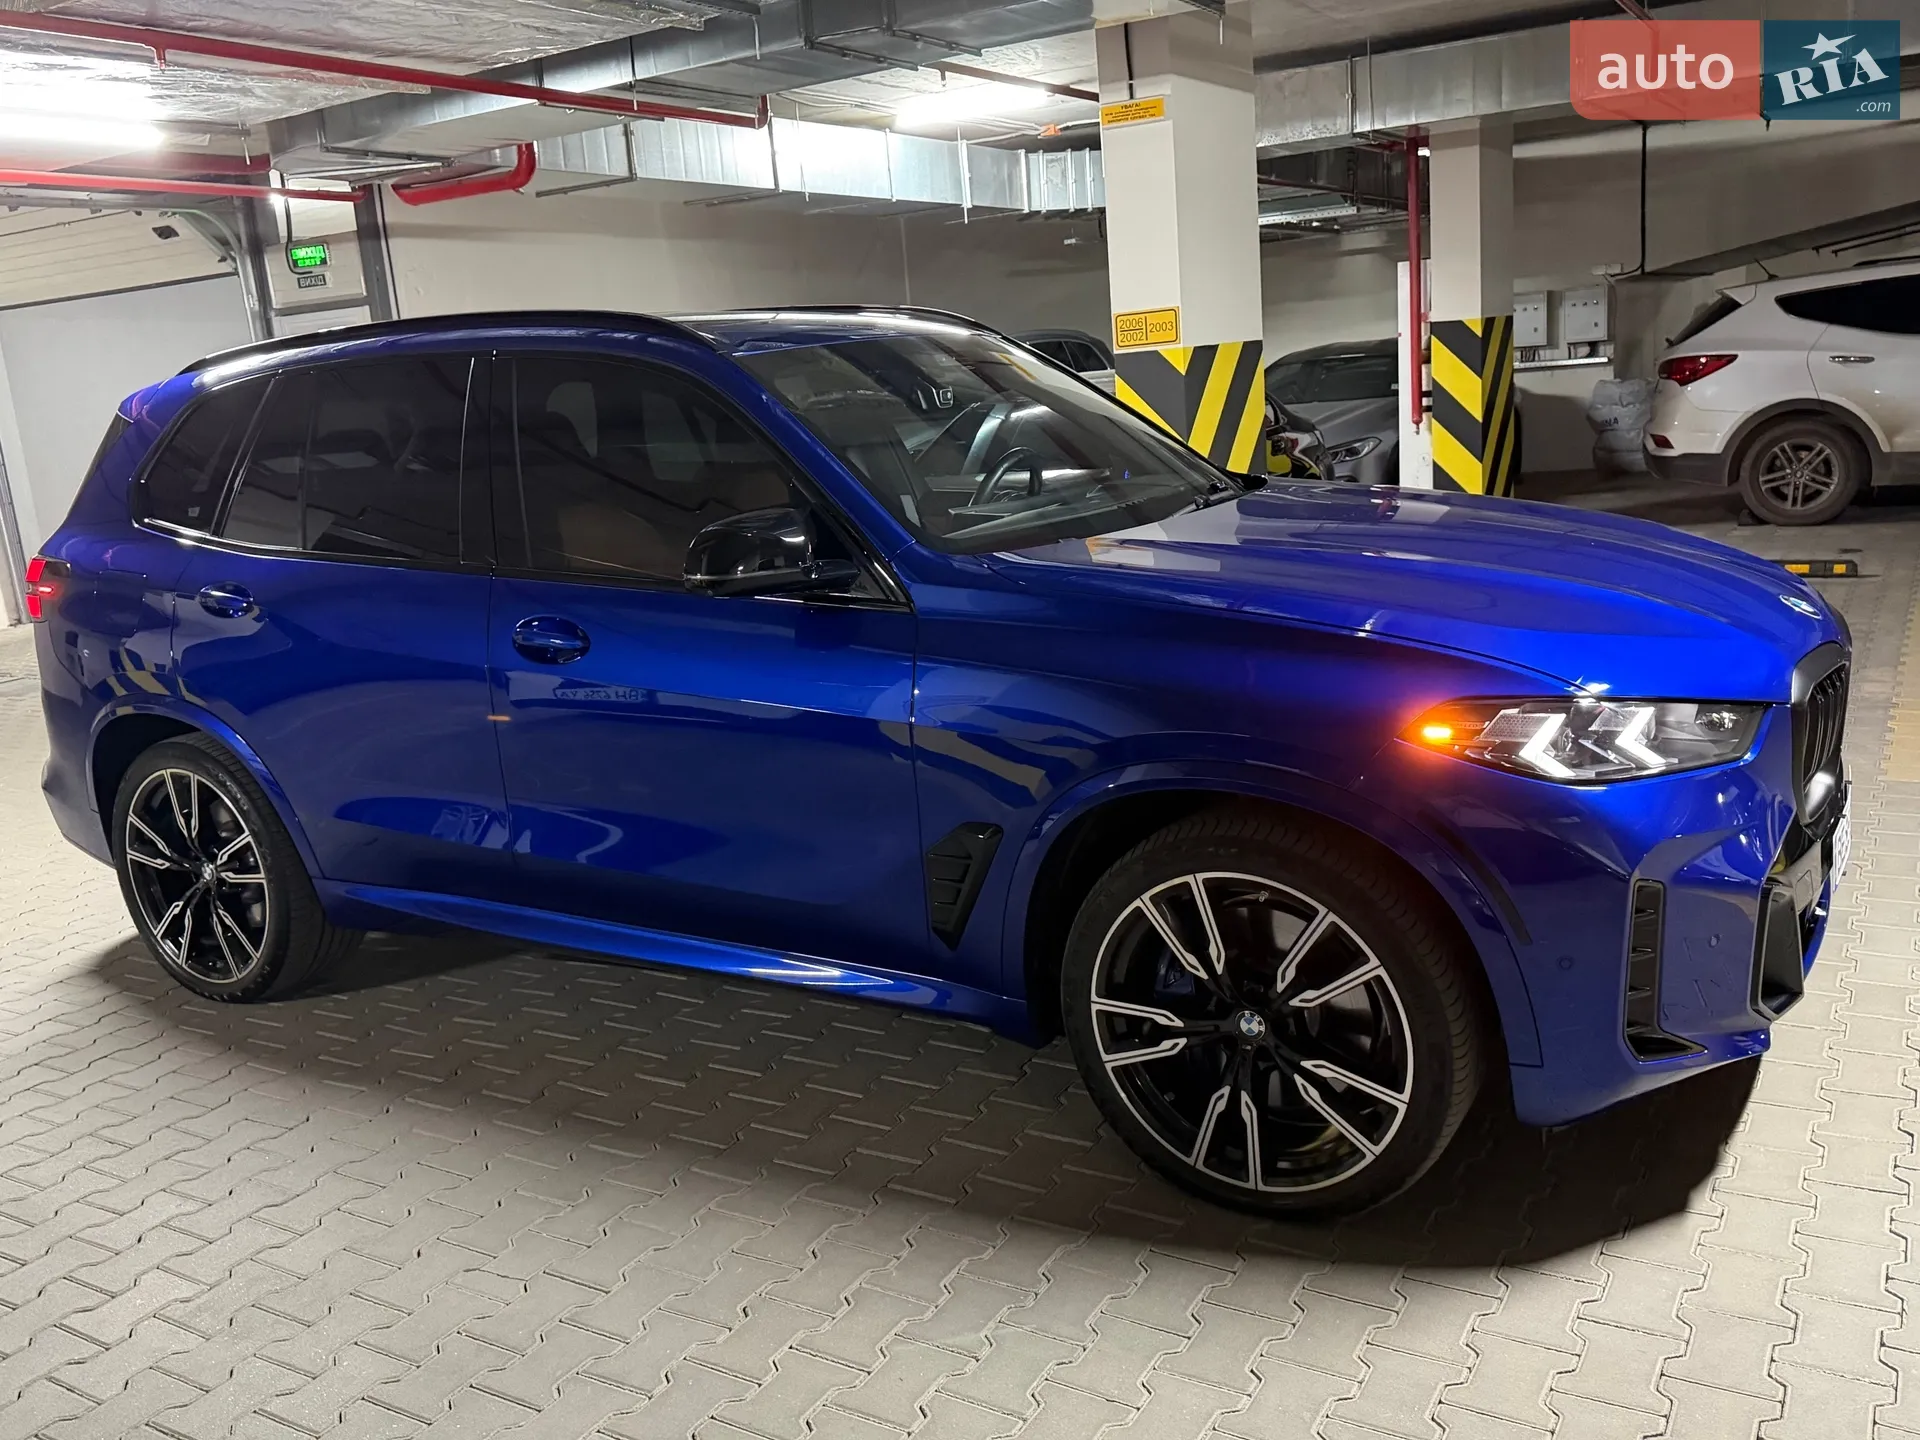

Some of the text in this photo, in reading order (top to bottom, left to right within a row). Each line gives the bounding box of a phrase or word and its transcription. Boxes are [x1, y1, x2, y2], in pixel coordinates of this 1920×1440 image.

[300, 275, 324, 287] ВИХІД
[1119, 317, 1144, 330] 2006
[1149, 320, 1174, 333] 2003
[1119, 331, 1144, 343] 2002
